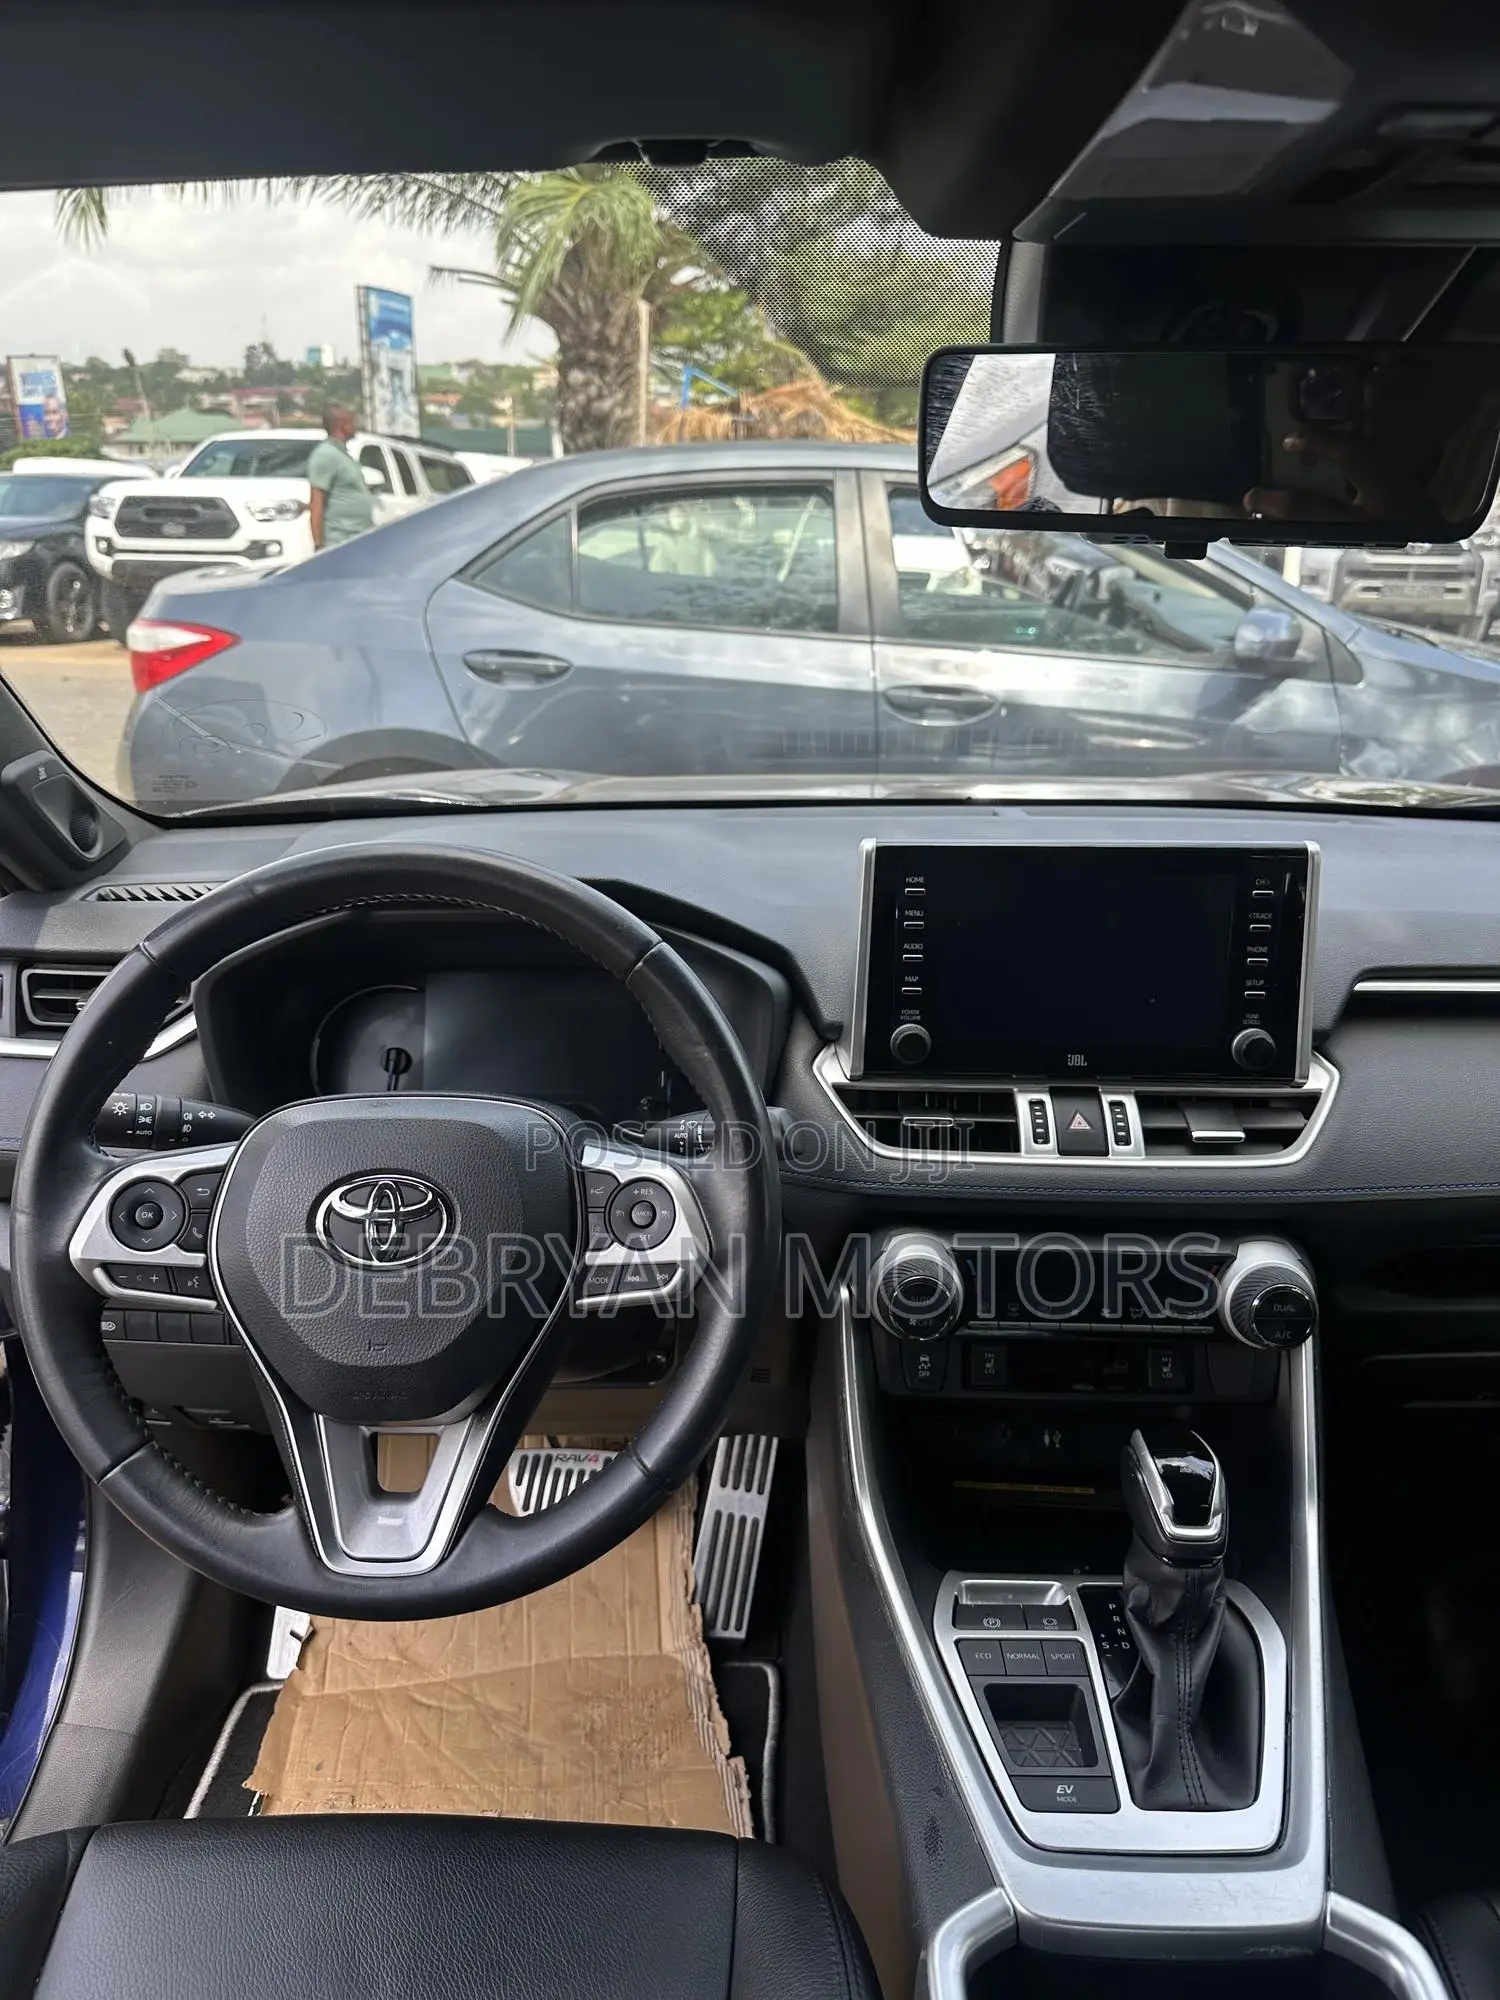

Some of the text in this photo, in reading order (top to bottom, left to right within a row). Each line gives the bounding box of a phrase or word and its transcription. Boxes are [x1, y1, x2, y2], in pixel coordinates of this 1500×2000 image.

[904, 909, 924, 917] MENU
[1246, 945, 1269, 953] PHONE
[1245, 979, 1265, 987] SETUP
[1067, 1054, 1088, 1066] JBL
[141, 1211, 154, 1219] OK
[1273, 1303, 1295, 1311] DUAL
[917, 1319, 933, 1327] OFF
[1275, 1330, 1292, 1339] A/C
[553, 1453, 601, 1464] RAV4
[1117, 1627, 1126, 1635] N
[1102, 1641, 1130, 1649] S D
[1006, 1652, 1040, 1660] NORMAL
[1050, 1652, 1076, 1660] SPORT
[1056, 1784, 1074, 1794] EV
